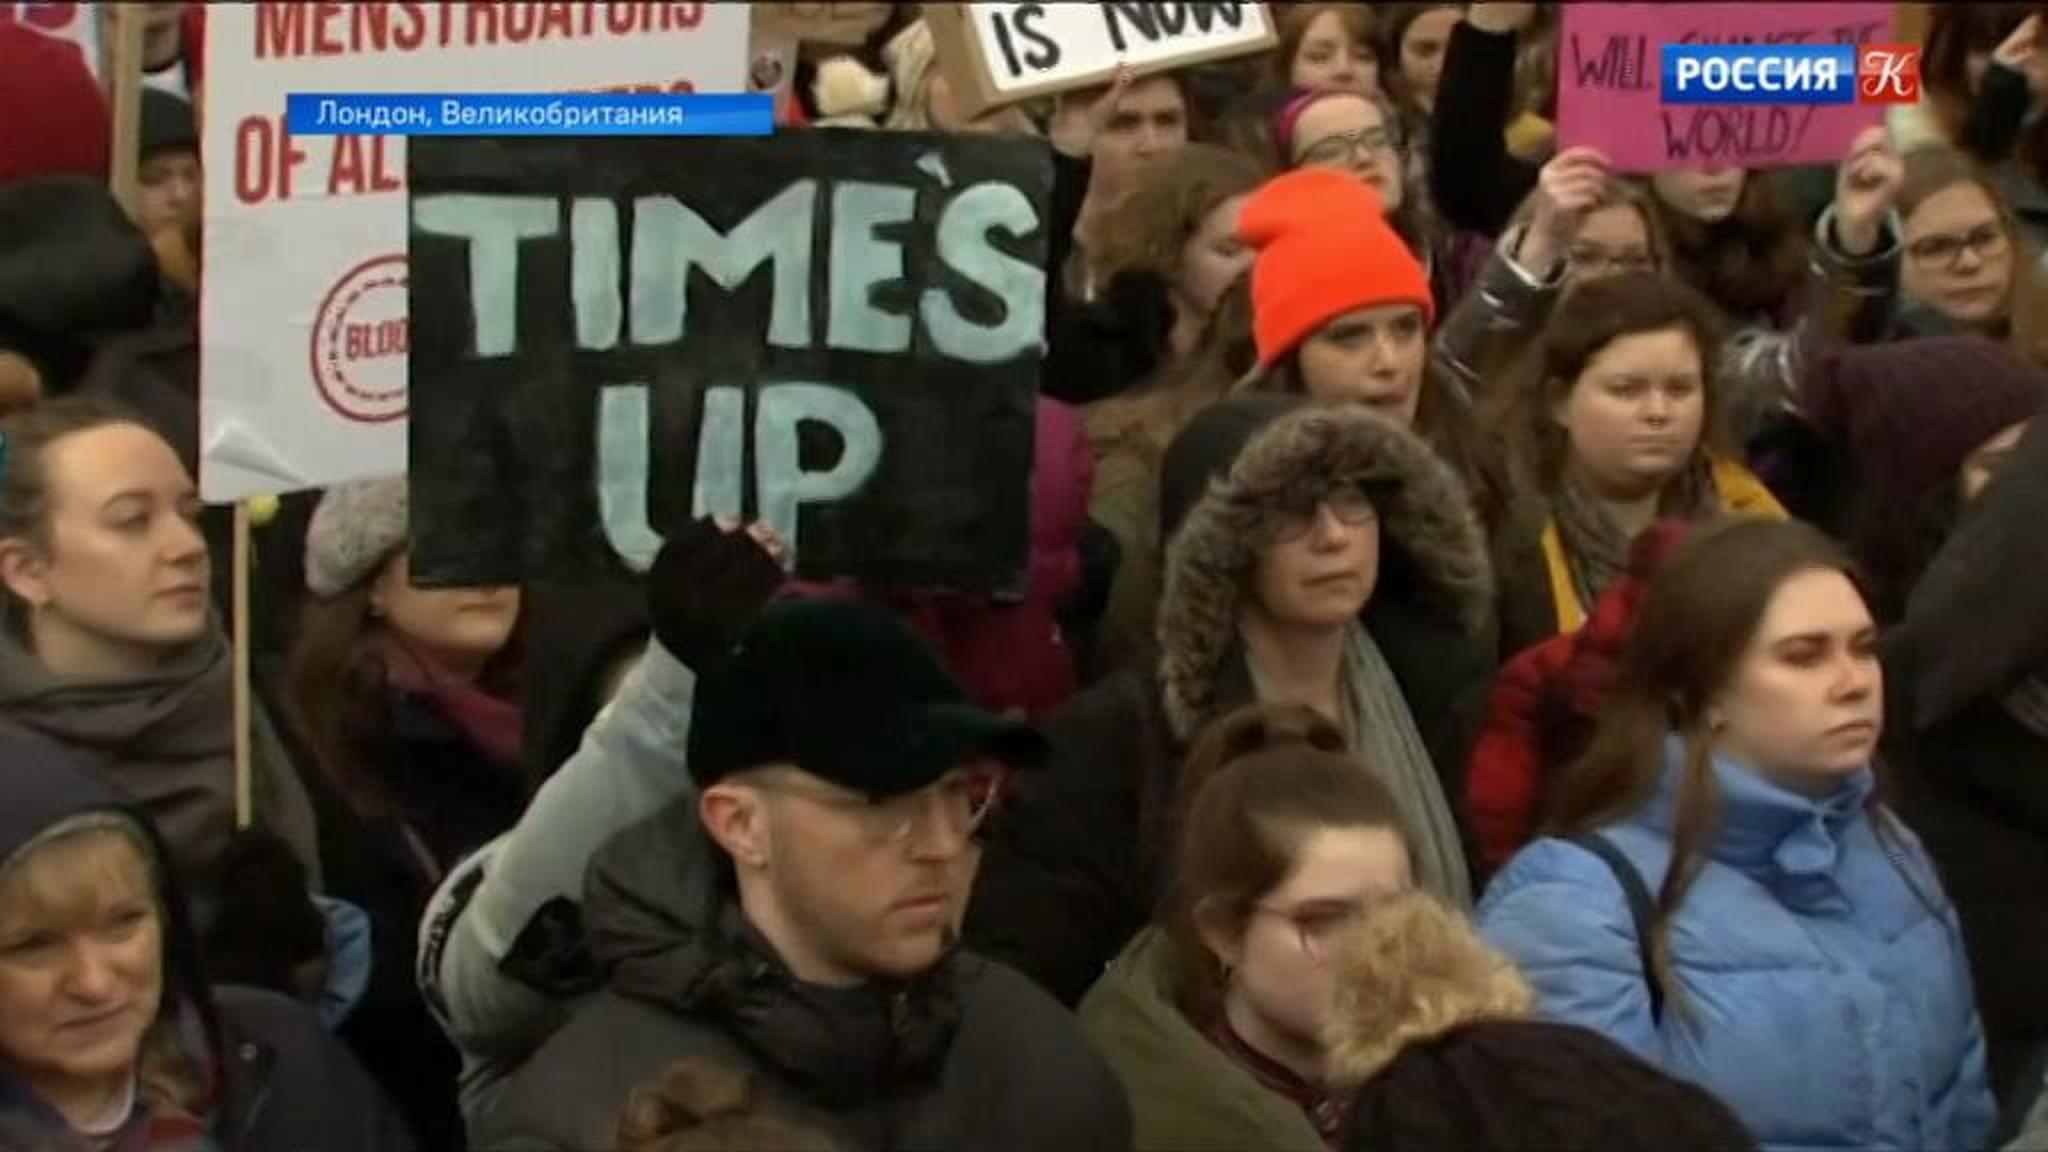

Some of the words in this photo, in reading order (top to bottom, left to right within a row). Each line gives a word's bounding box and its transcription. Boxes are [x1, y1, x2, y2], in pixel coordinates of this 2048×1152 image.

[991, 3, 1060, 77] IS
[1571, 33, 1655, 91] WILL
[235, 114, 306, 204] OF
[412, 153, 1048, 364] TIME'S
[596, 382, 884, 574] UP
